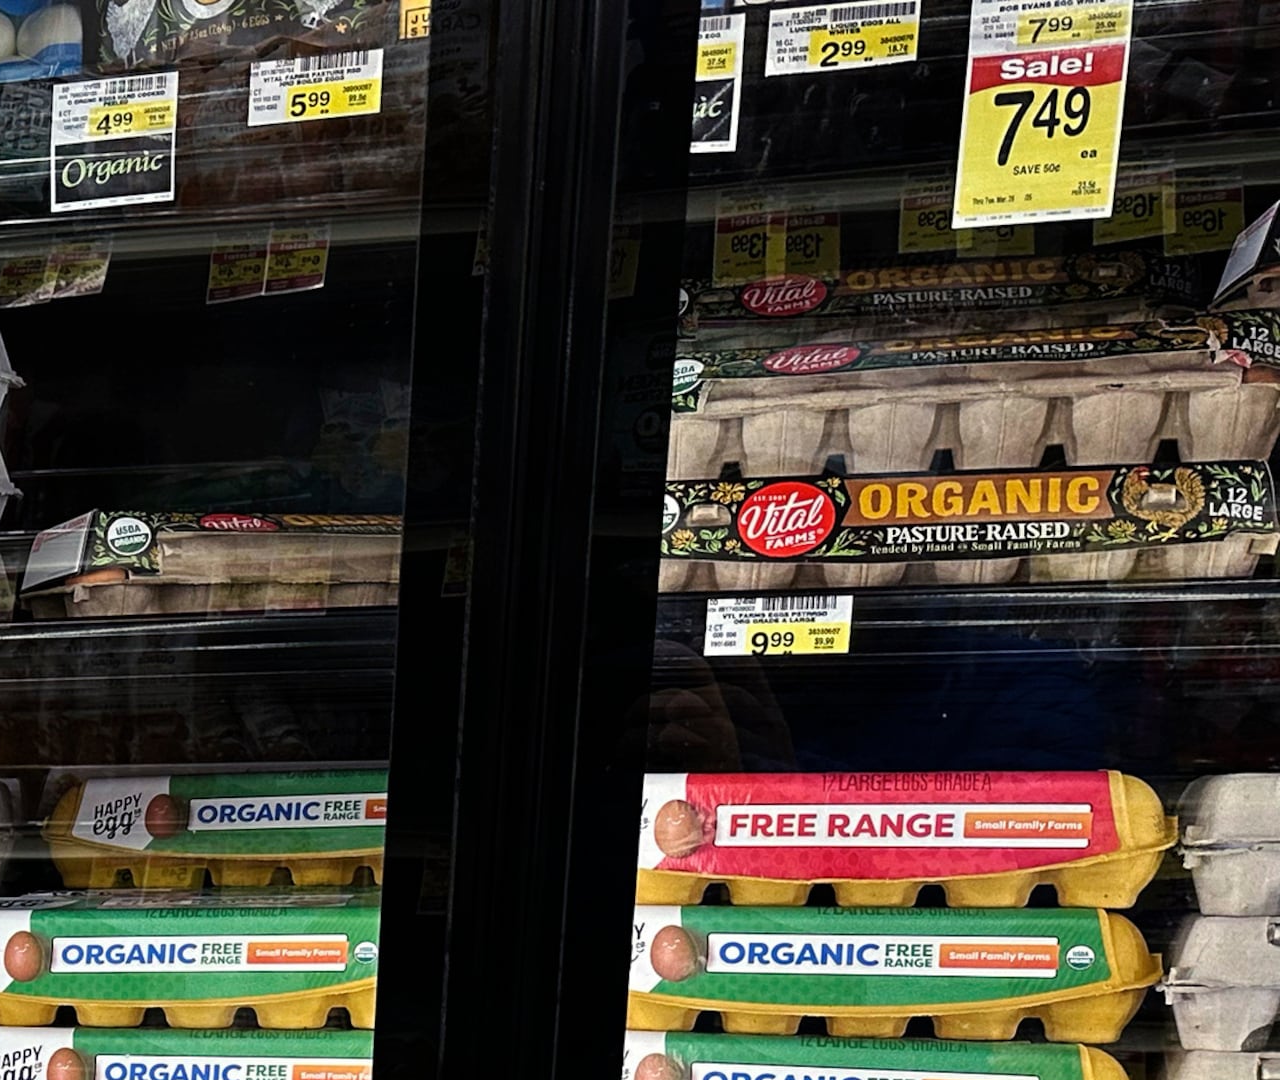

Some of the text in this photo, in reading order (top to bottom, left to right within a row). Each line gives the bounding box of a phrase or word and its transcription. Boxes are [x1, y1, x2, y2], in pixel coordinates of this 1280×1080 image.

[1022, 2, 1052, 10] EVANS
[1000, 52, 1094, 79] Sale!
[1081, 150, 1097, 158] ea
[62, 151, 164, 188] Organic
[1013, 165, 1040, 176] SAVE
[874, 286, 1032, 306] PASTURE-RAISED
[859, 476, 1100, 520] ORGANIC
[1226, 486, 1248, 504] 12
[741, 496, 822, 538] Vital
[1209, 502, 1263, 521] LARGE
[117, 525, 141, 536] USDA
[886, 522, 1070, 544] PASTURE-RAISED
[765, 532, 817, 550] FARMS
[871, 538, 1080, 554] Tended by Hand Small Family Farms
[729, 813, 955, 839] FREE RANGE
[974, 819, 1083, 832] Small Family Farms
[61, 943, 197, 967] ORGANIC
[201, 943, 242, 955] FREE
[255, 948, 341, 959] Small Family Farms
[718, 941, 879, 967] ORGANIC
[200, 954, 242, 965] RANGE
